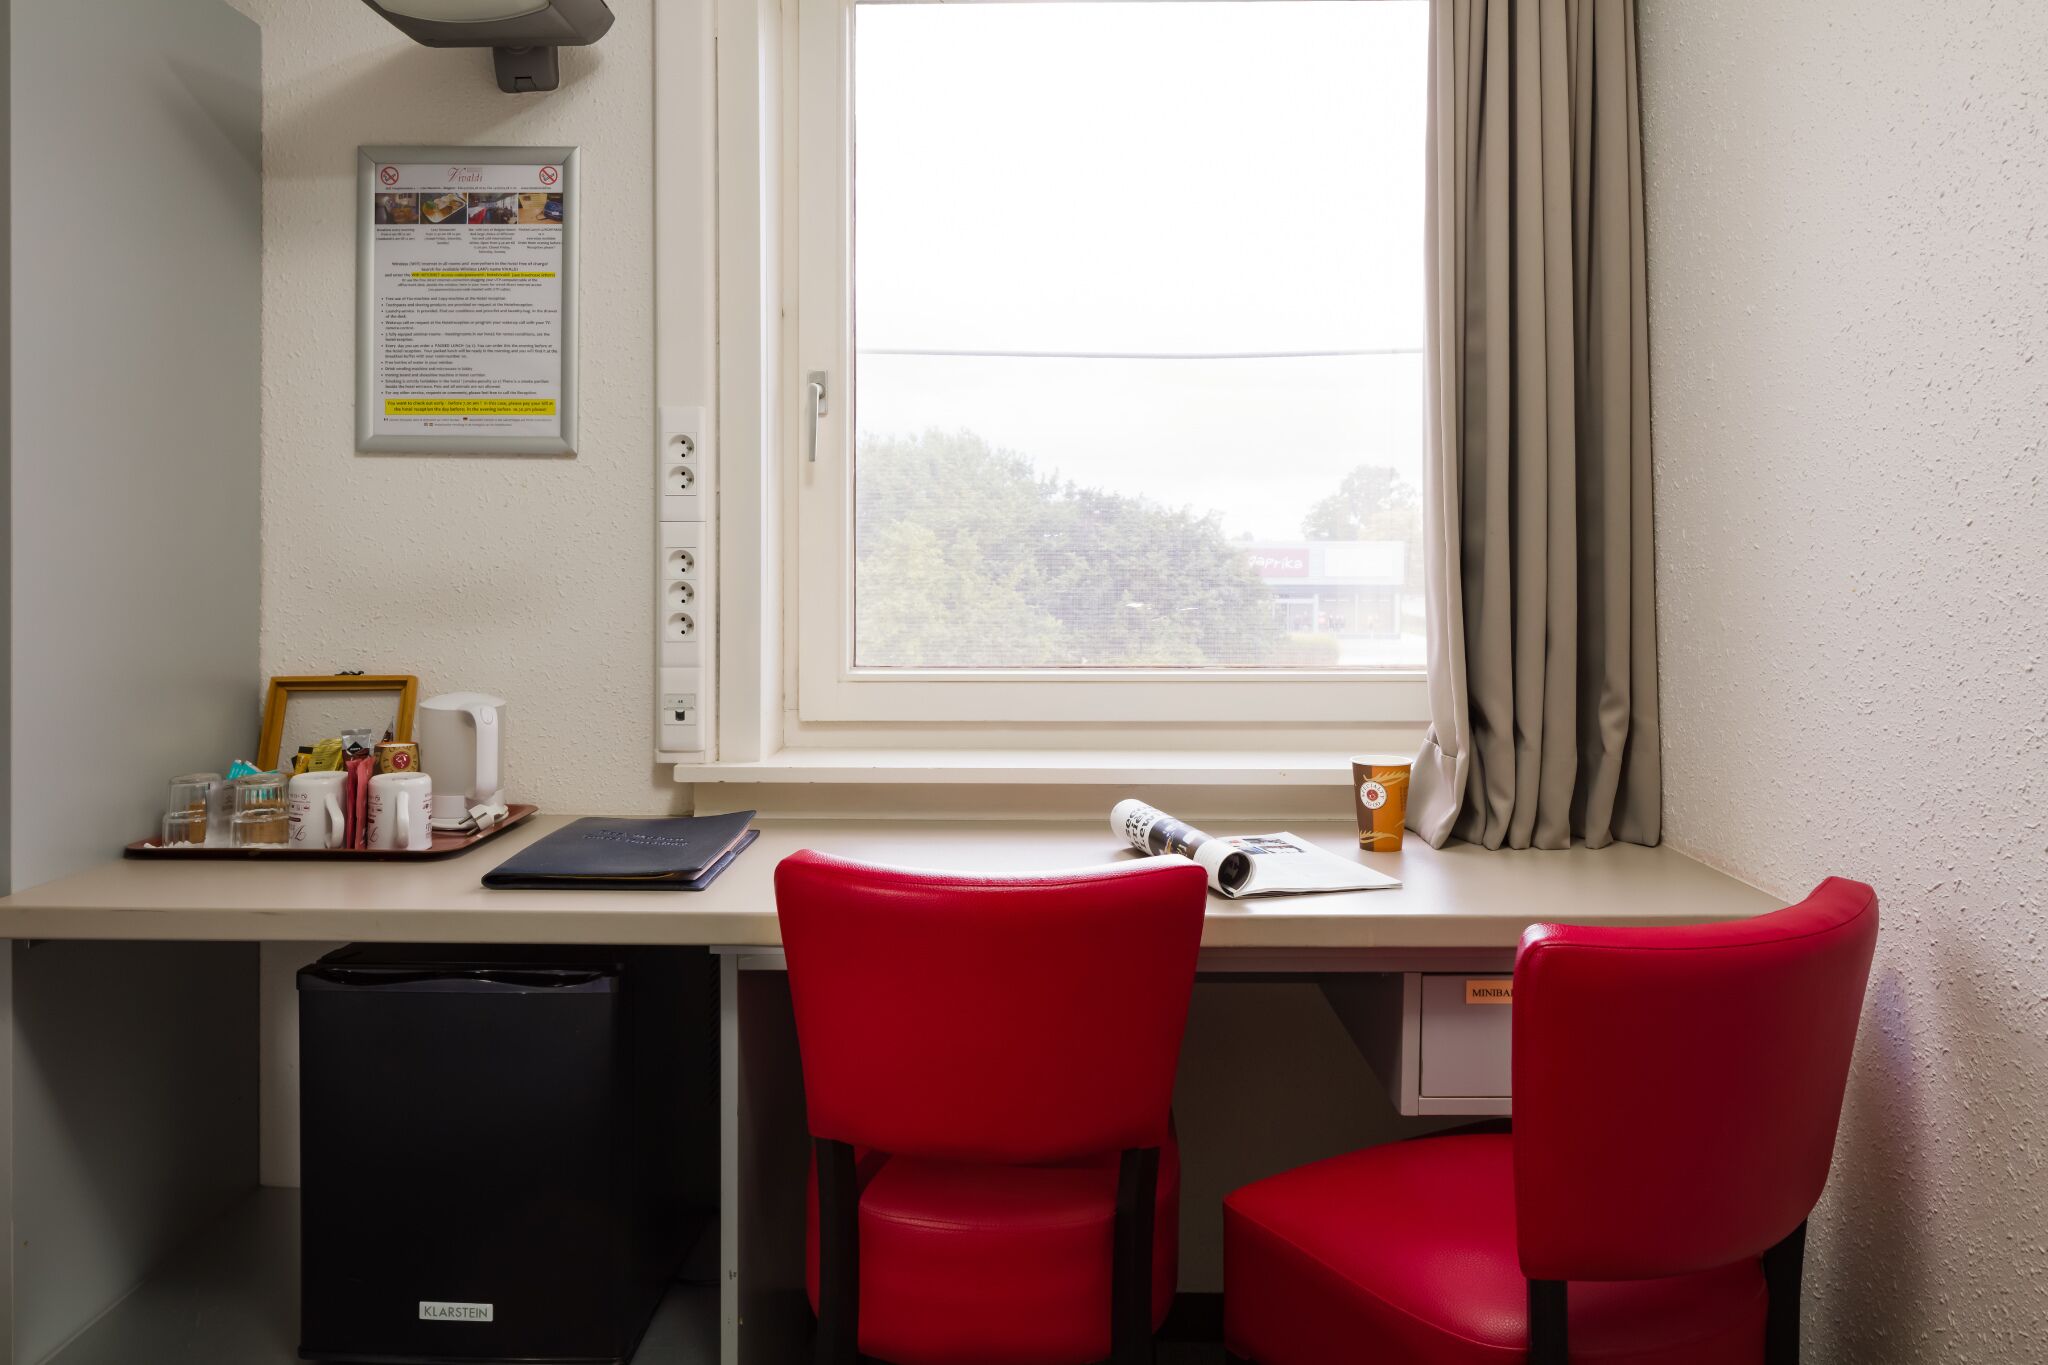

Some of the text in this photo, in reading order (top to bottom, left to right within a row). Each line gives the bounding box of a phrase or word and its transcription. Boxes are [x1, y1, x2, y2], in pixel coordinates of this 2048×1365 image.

[1248, 555, 1303, 569] paprika
[1472, 988, 1512, 997] MINIBA
[424, 1306, 488, 1318] KLARSTEIN
